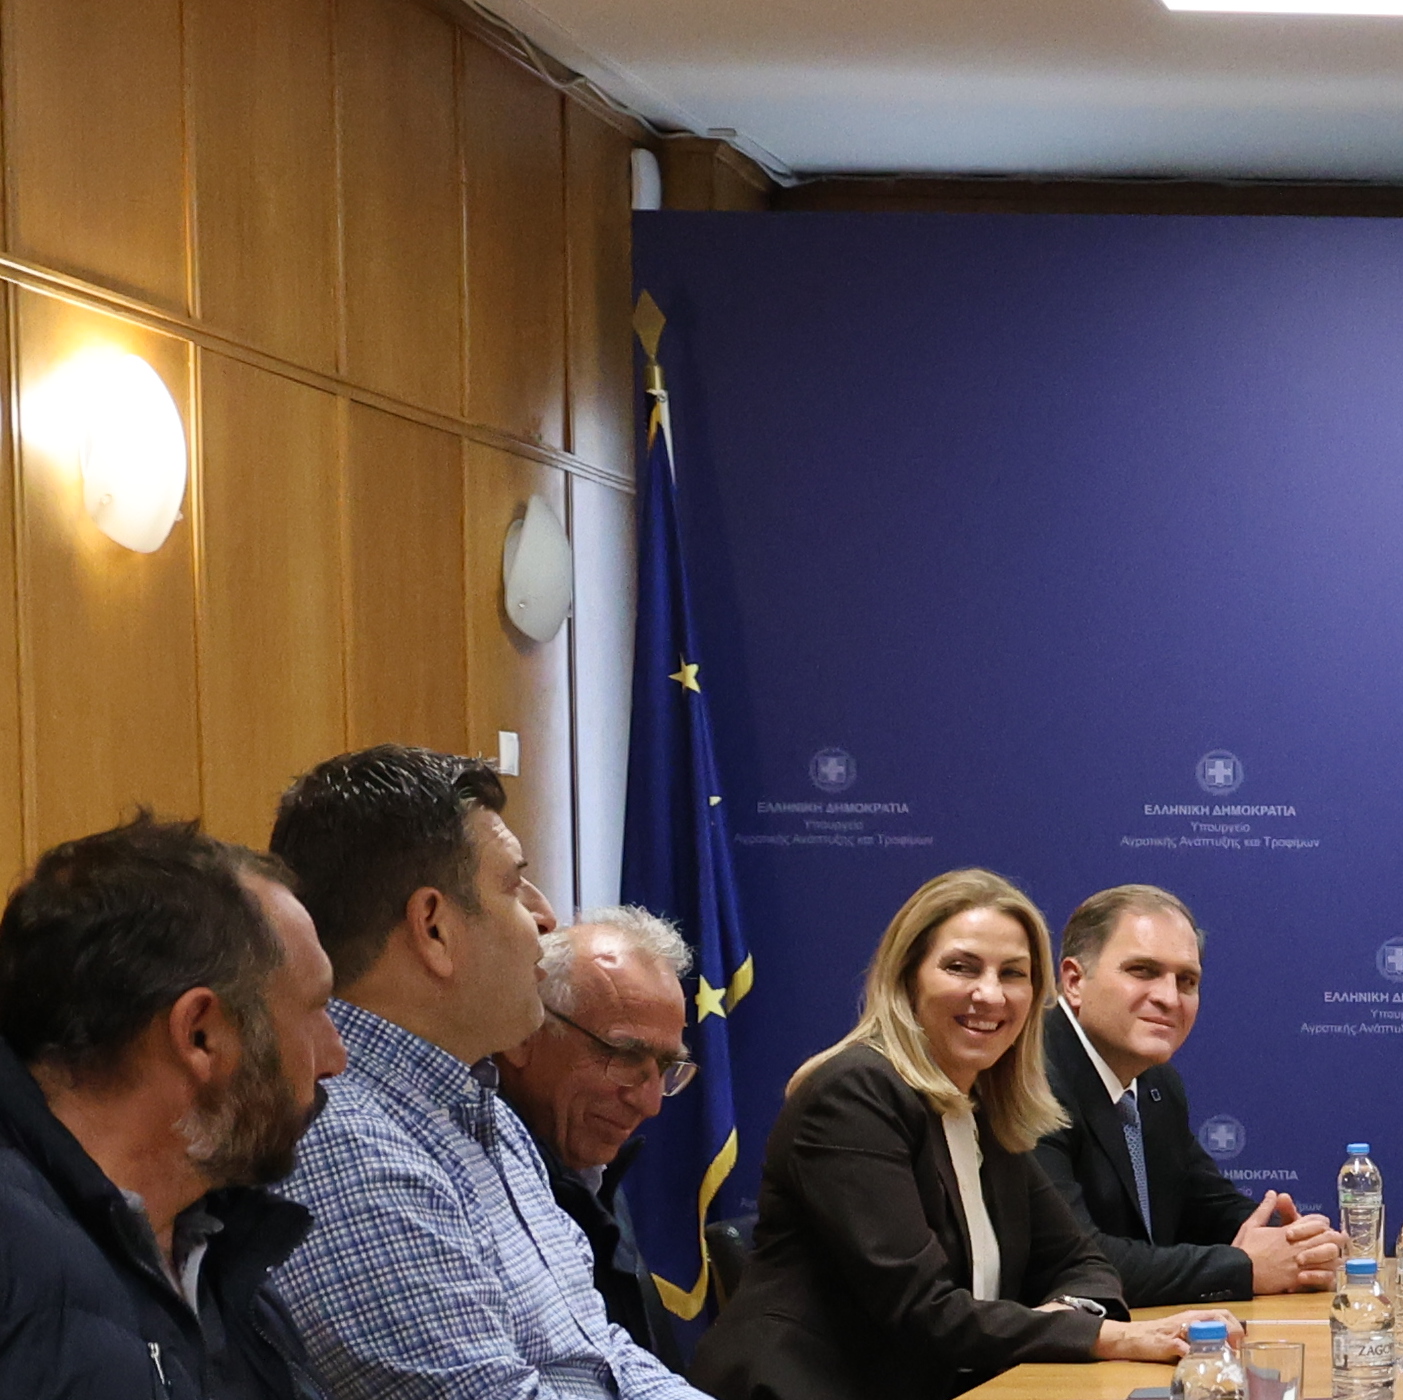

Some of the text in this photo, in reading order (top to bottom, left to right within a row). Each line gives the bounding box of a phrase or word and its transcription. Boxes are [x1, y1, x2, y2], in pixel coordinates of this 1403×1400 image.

[757, 802, 909, 814] ΕΛΛΗΝΙΚΗ ΔΗΜΟΚΡΑΤΙΑ
[1144, 804, 1296, 816] ΕΛΛΗΝΙΚΗ ΔΗΜΟΚΡΑΤΙΑ
[1190, 821, 1250, 834] Υπουργείο
[1324, 991, 1389, 1003] ΕΛΛΗΝΙΚΗ
[1220, 1169, 1299, 1181] ΗΜΟΚΡΑΤΙΑ
